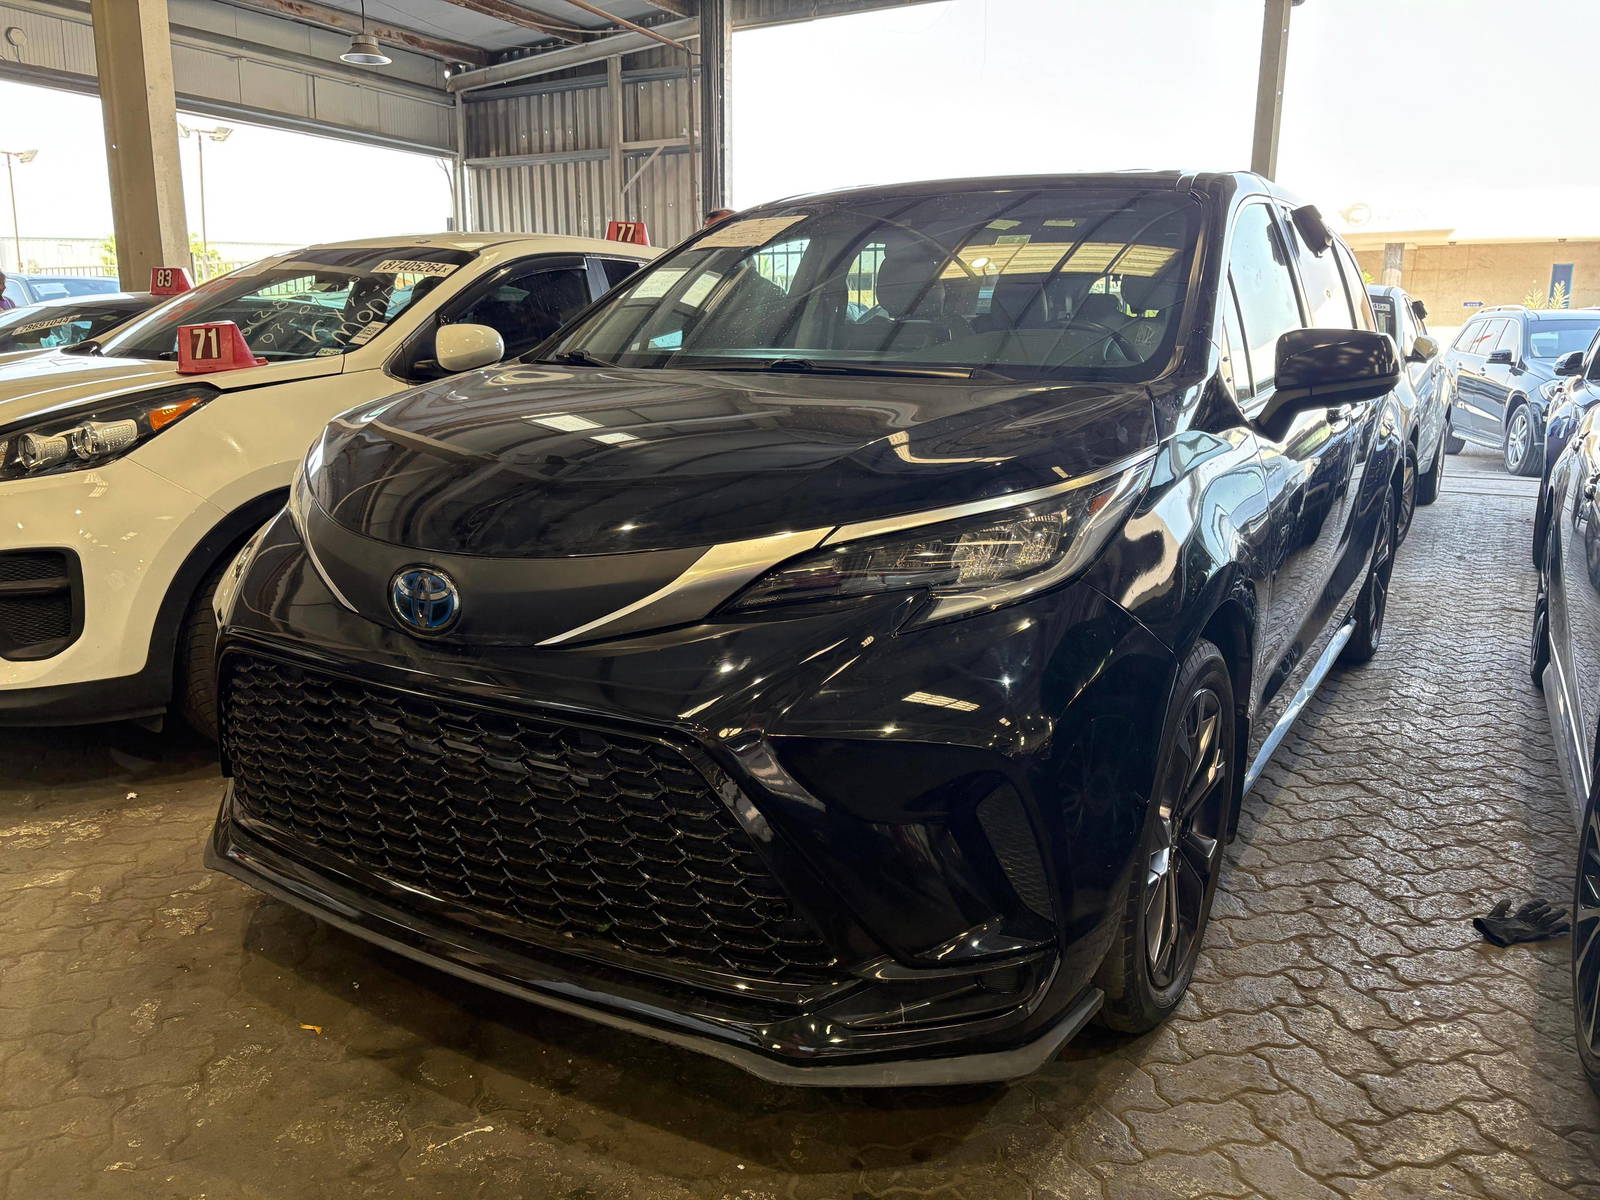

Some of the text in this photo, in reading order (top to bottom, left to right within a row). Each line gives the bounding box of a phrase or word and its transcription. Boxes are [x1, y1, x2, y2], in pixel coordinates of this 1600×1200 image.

[617, 223, 635, 242] 77
[157, 269, 172, 287] 83
[192, 328, 218, 359] 71
